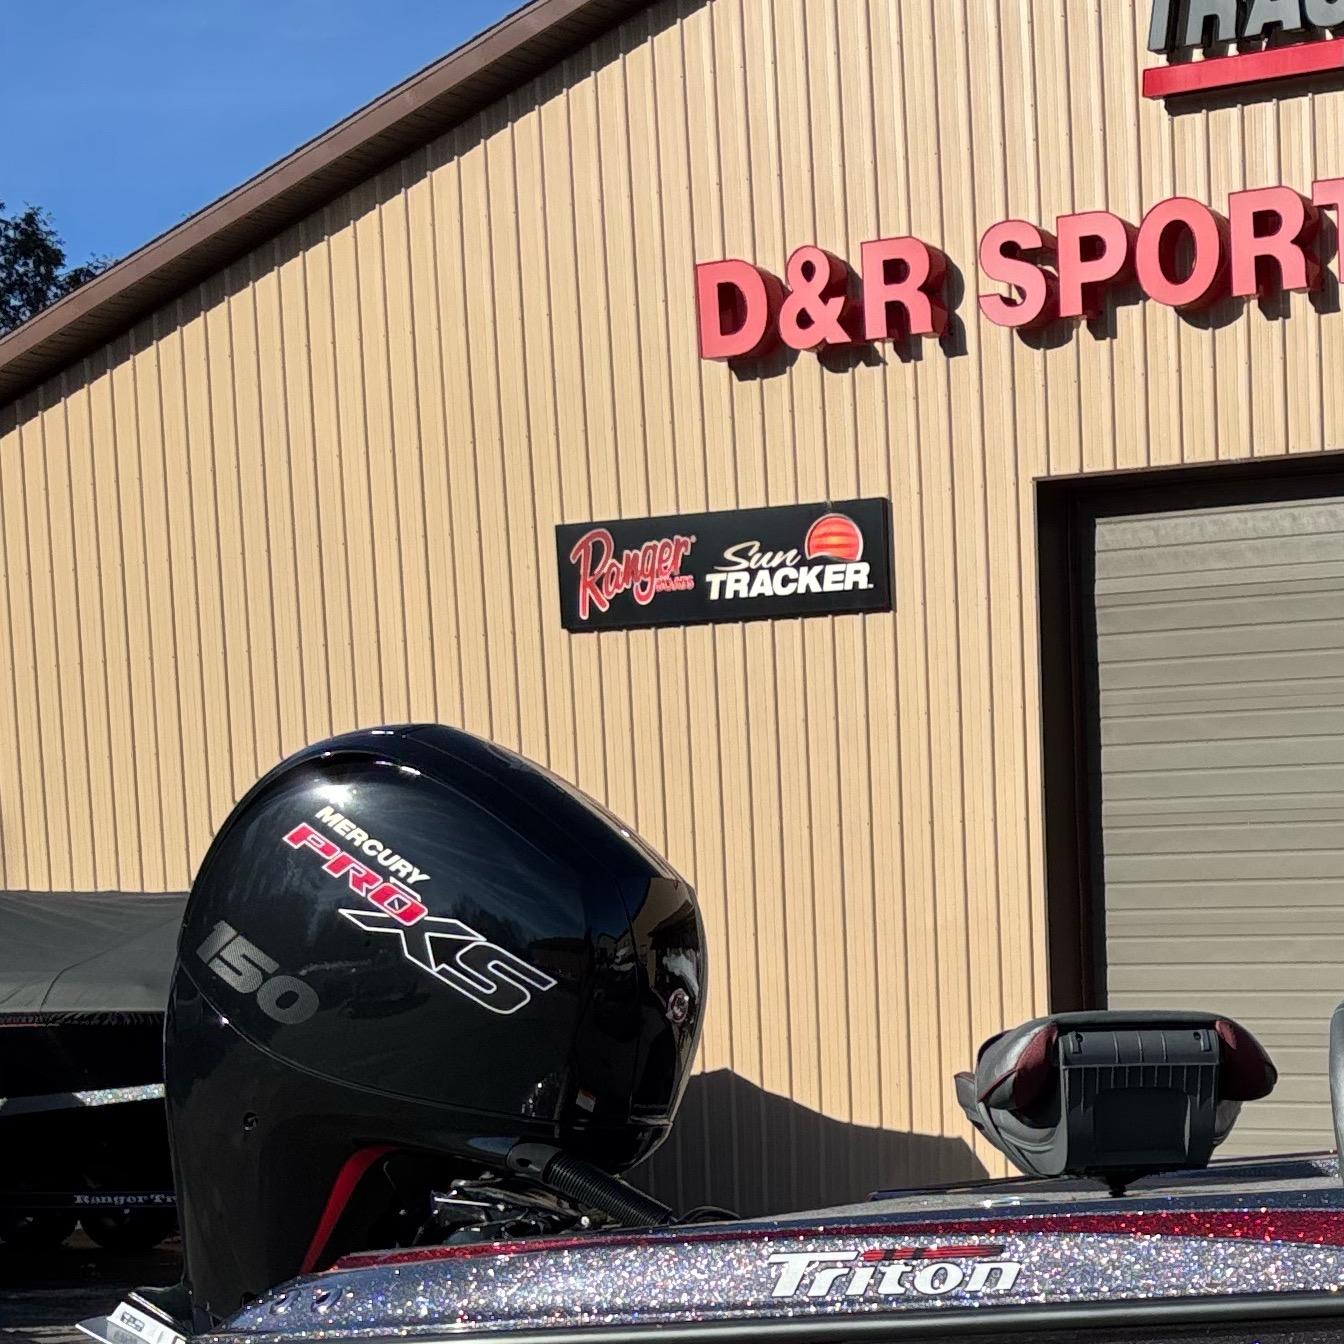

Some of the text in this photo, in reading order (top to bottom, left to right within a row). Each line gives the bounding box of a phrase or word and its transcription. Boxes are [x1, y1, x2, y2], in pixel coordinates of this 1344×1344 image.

[695, 235, 945, 361] D&R
[570, 528, 692, 619] Ranger
[713, 540, 801, 571] Sun
[315, 806, 430, 887] MERCURY
[283, 822, 558, 1014] PRO XS
[197, 920, 319, 1025] 150
[768, 1250, 1022, 1297] Triton
